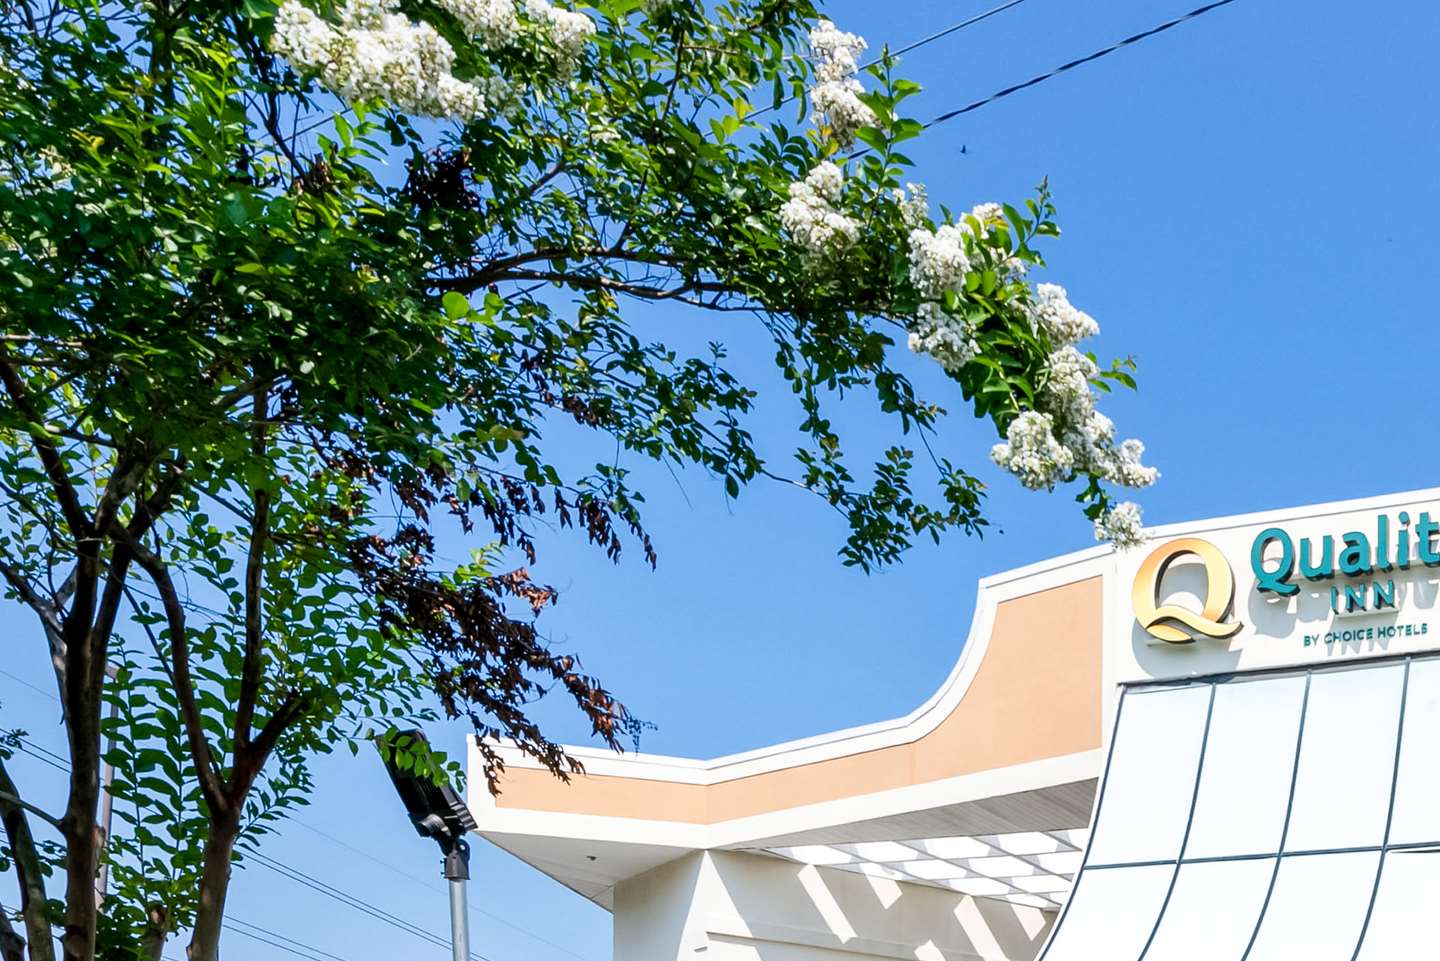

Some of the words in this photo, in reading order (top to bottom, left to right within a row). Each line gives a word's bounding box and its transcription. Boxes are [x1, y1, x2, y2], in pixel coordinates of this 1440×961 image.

[1132, 538, 1244, 642] Q
[1330, 579, 1395, 615] INN
[1303, 634, 1320, 647] BY
[1324, 627, 1374, 645] CHOICE
[1377, 622, 1428, 639] HOTELS
